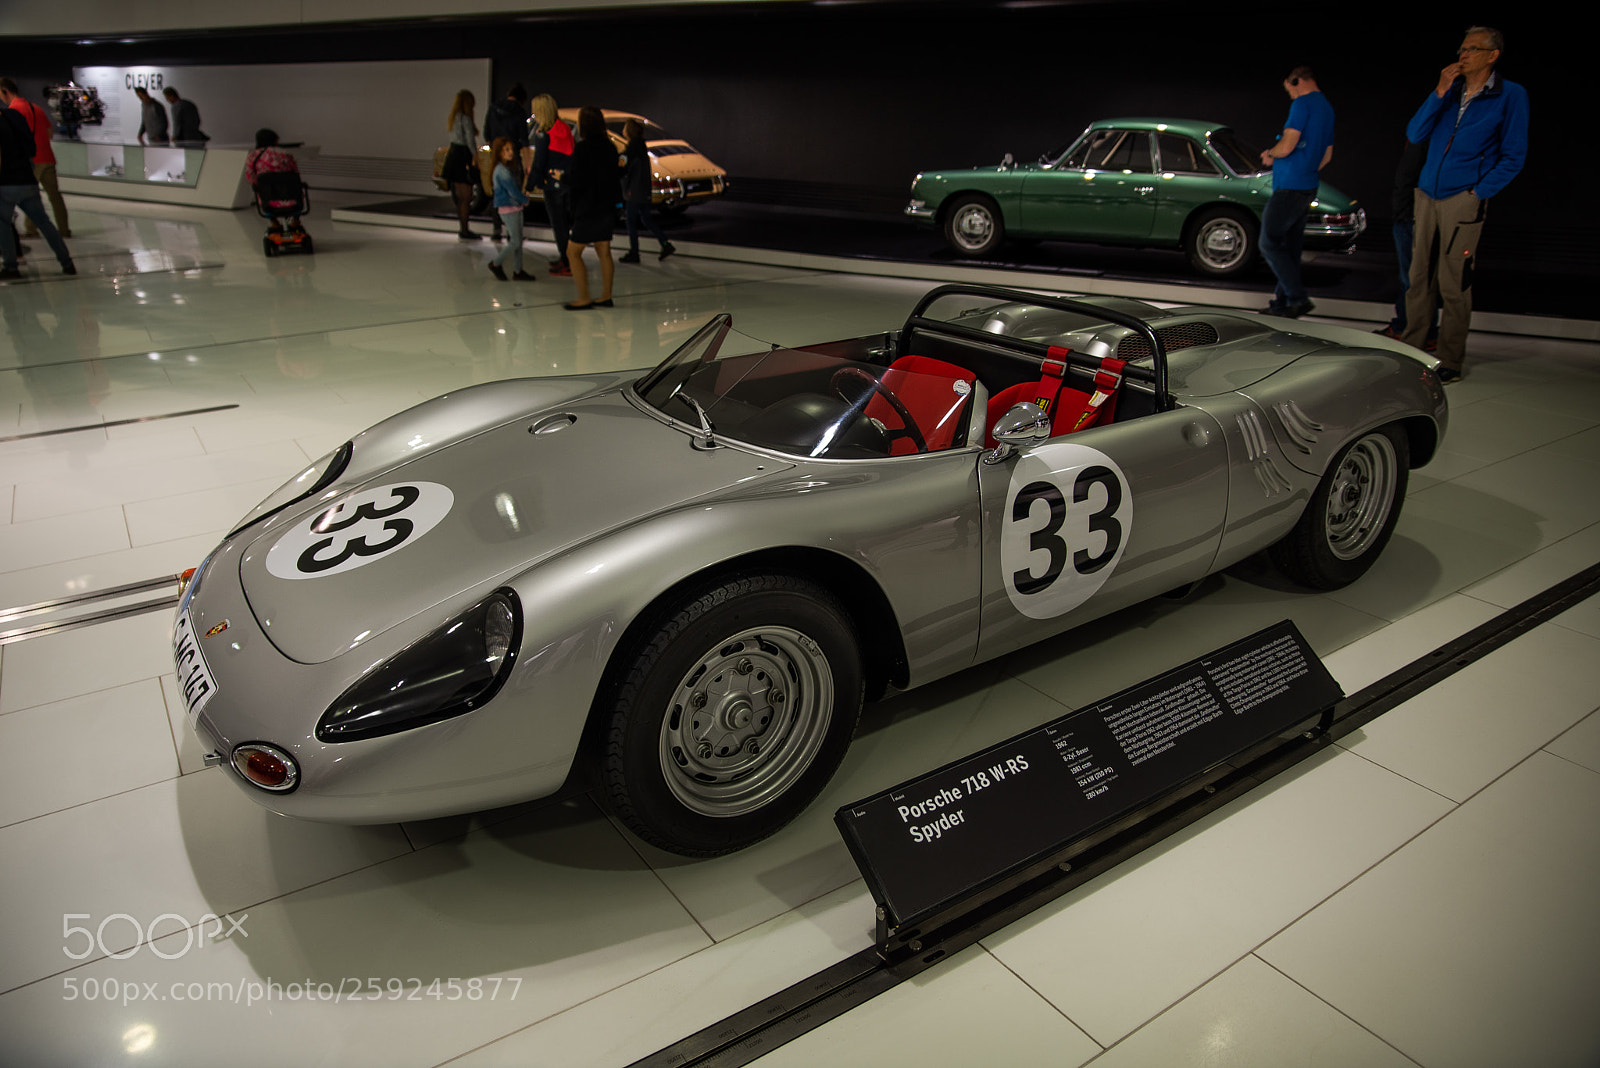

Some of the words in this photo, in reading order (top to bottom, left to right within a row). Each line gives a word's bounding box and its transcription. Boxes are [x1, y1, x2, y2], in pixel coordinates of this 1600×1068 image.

[125, 73, 163, 90] CLEVER
[297, 486, 420, 573] 33
[1012, 466, 1123, 596] 33
[1056, 741, 1067, 749] 1962
[898, 788, 962, 822] Porsche
[961, 772, 990, 794] 718
[989, 755, 1028, 781] W-RS
[1095, 786, 1108, 795] km/h
[910, 810, 964, 842] Spyder
